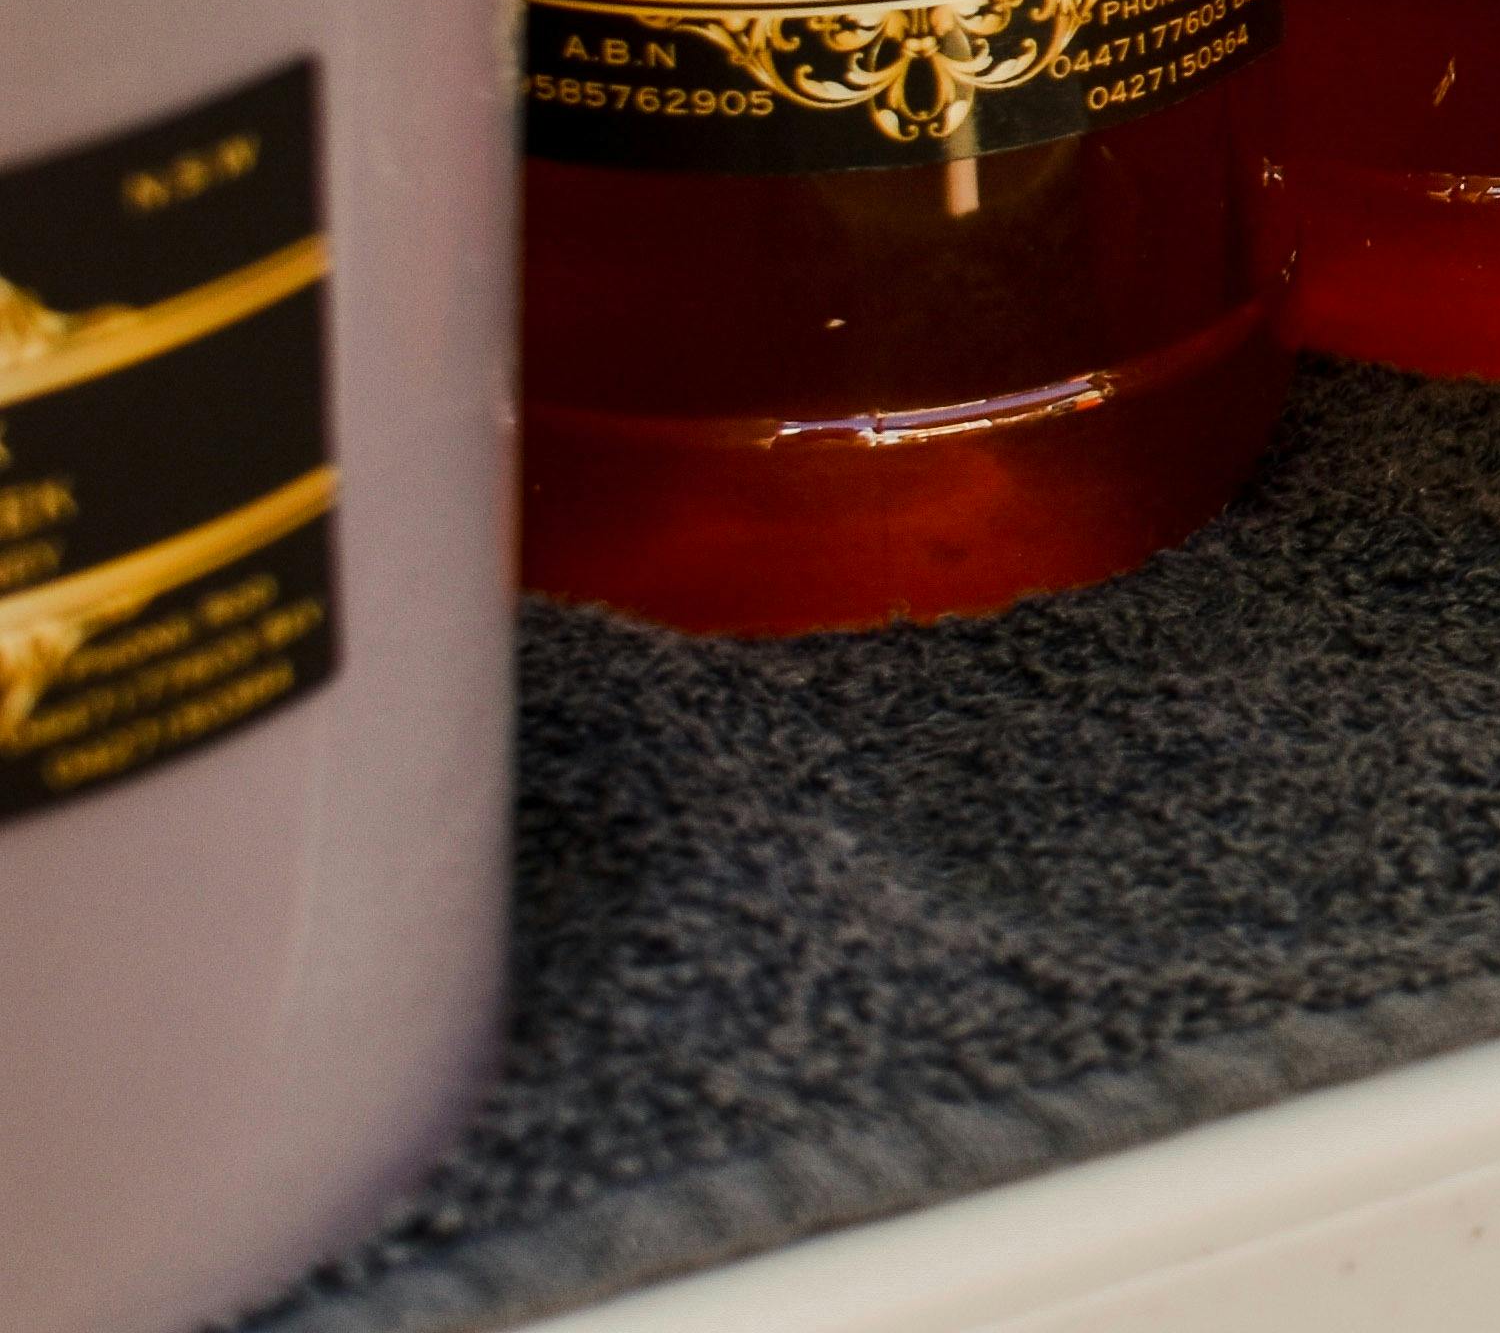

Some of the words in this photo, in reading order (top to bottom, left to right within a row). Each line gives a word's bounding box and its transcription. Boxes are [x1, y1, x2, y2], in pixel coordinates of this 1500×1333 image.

[563, 35, 676, 69] A.B.N
[1087, 23, 1249, 110] 0427150364
[523, 74, 775, 116] 585762905
